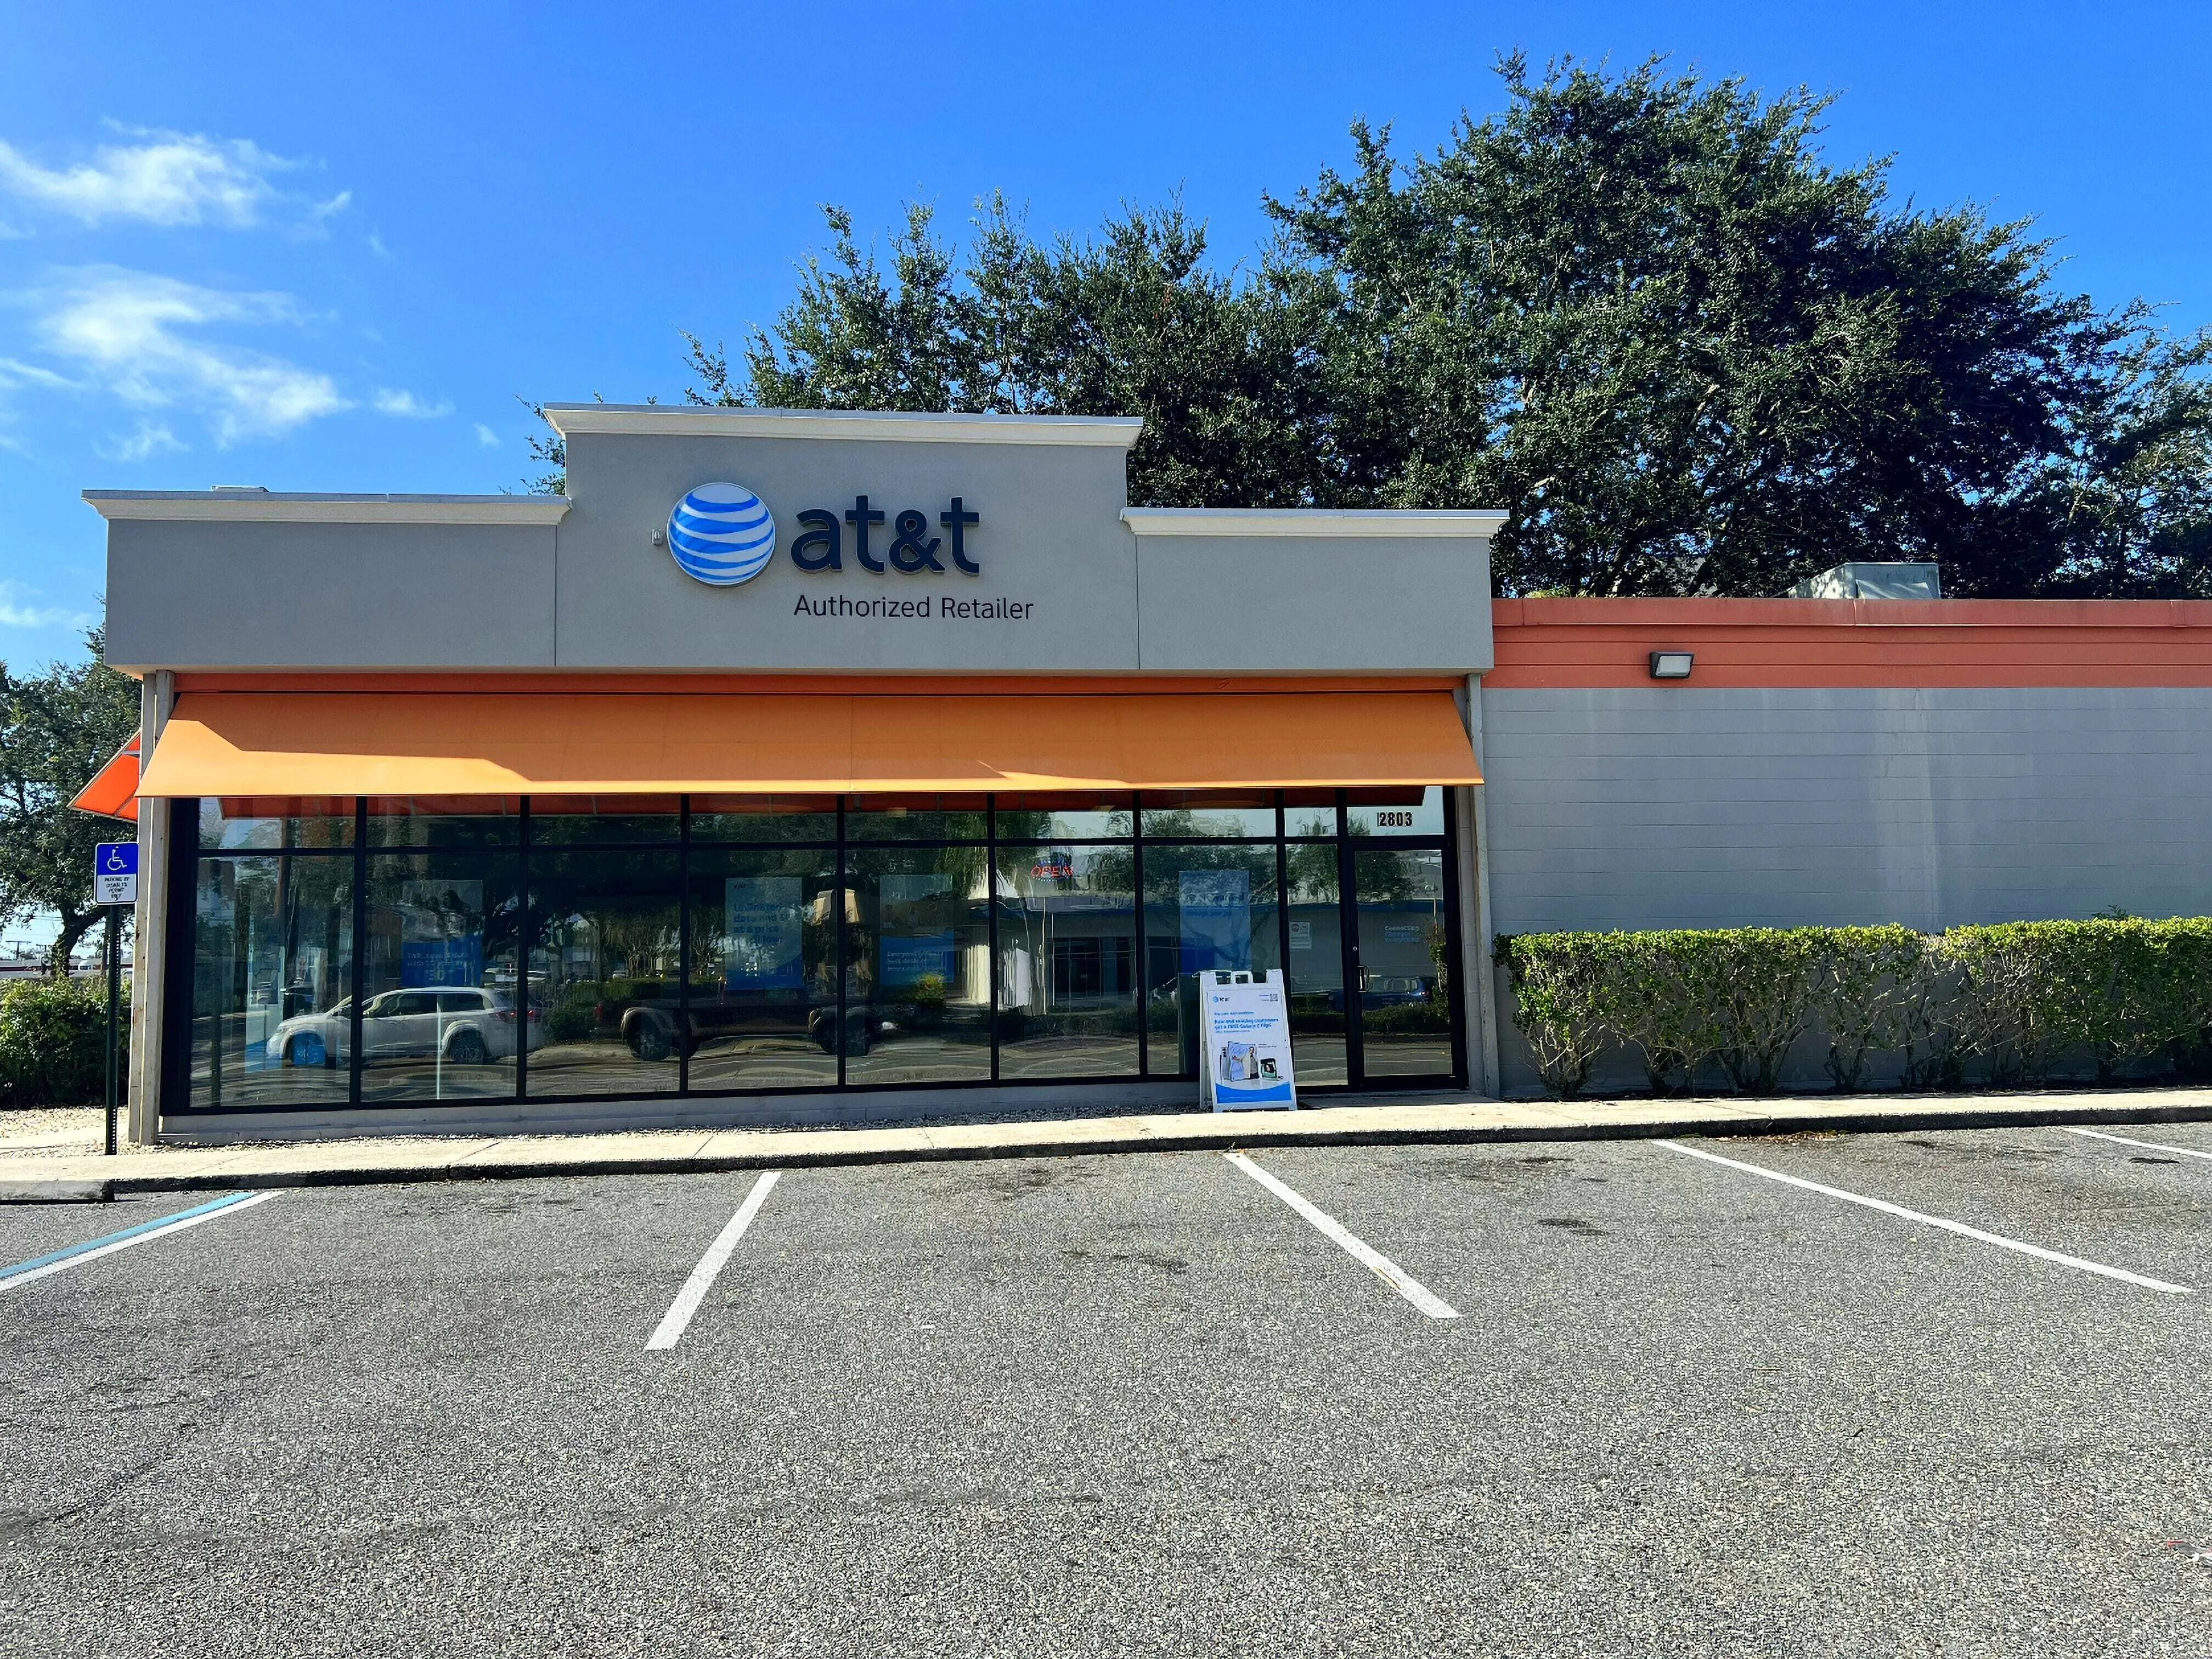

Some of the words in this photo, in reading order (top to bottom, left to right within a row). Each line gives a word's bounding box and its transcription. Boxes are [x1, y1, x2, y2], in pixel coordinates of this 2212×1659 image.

[791, 495, 981, 577] at&t
[794, 595, 930, 618] Authorized
[941, 597, 1034, 620] Retailer
[1379, 812, 1412, 826] 2803
[1031, 865, 1074, 878] OPEN
